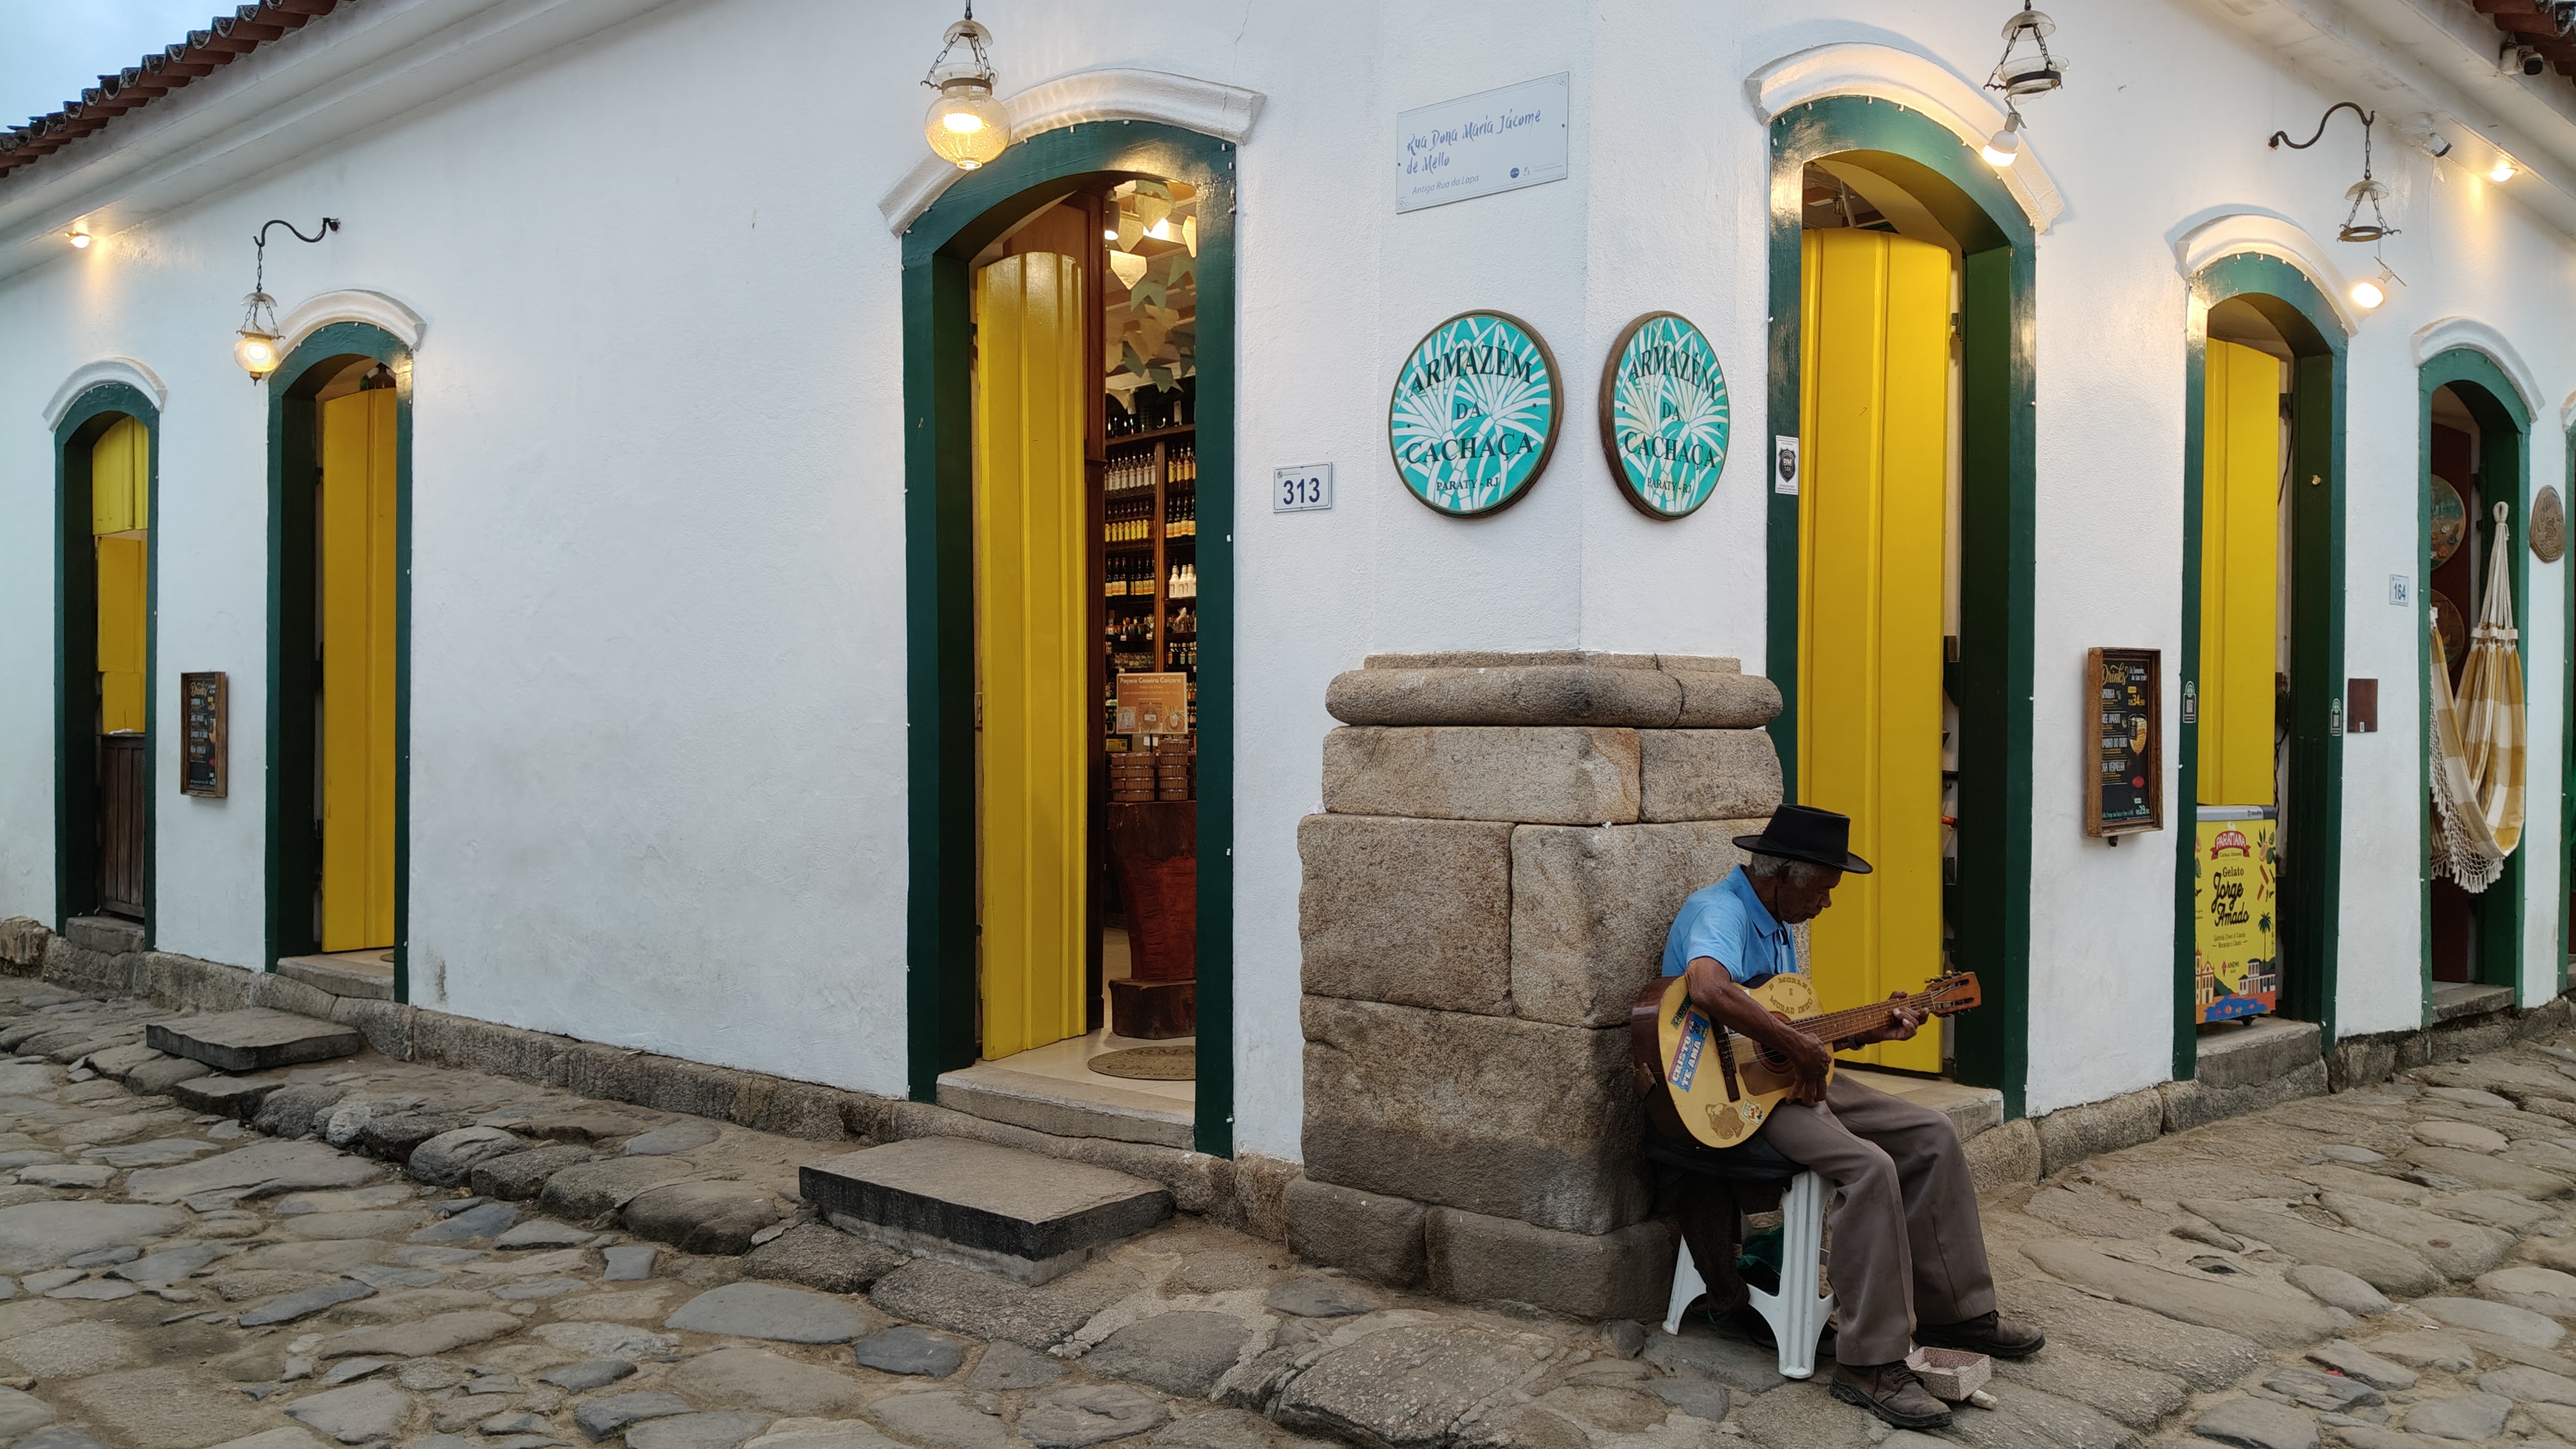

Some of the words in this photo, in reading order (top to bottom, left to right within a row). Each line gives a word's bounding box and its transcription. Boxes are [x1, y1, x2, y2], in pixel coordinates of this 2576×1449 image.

[1407, 133, 1427, 156] Rua
[1429, 129, 1458, 151] Dona
[1496, 108, 1541, 135] Jácome
[1406, 157, 1418, 175] de
[1422, 152, 1450, 175] Mello
[1412, 182, 1435, 195] Antiga
[1436, 180, 1450, 190] Rua
[1451, 177, 1460, 187] da
[1462, 174, 1479, 186] Lapa
[1409, 340, 1533, 397] ARMAZÉM
[1628, 345, 1716, 402] ARMAZÉM
[1456, 401, 1482, 419] DA
[1662, 402, 1680, 421] DA
[1406, 432, 1535, 464] CACHAÇA
[1624, 431, 1716, 470] CACHAÇA
[1283, 477, 1320, 505] 313
[1436, 478, 1478, 492] PARATY
[1486, 477, 1499, 488] RJ
[1647, 477, 1677, 492] PARATY
[1682, 483, 1692, 494] RJ
[2394, 583, 2406, 601] 164
[2216, 832, 2246, 850] PARATIANA
[2223, 866, 2244, 877] Gelato
[2211, 872, 2244, 914] Jorge
[2214, 901, 2250, 927] Amado
[1672, 1035, 1692, 1082] CRISTO
[1681, 1069, 1692, 1087] TE
[1687, 1040, 1702, 1069] AMA
